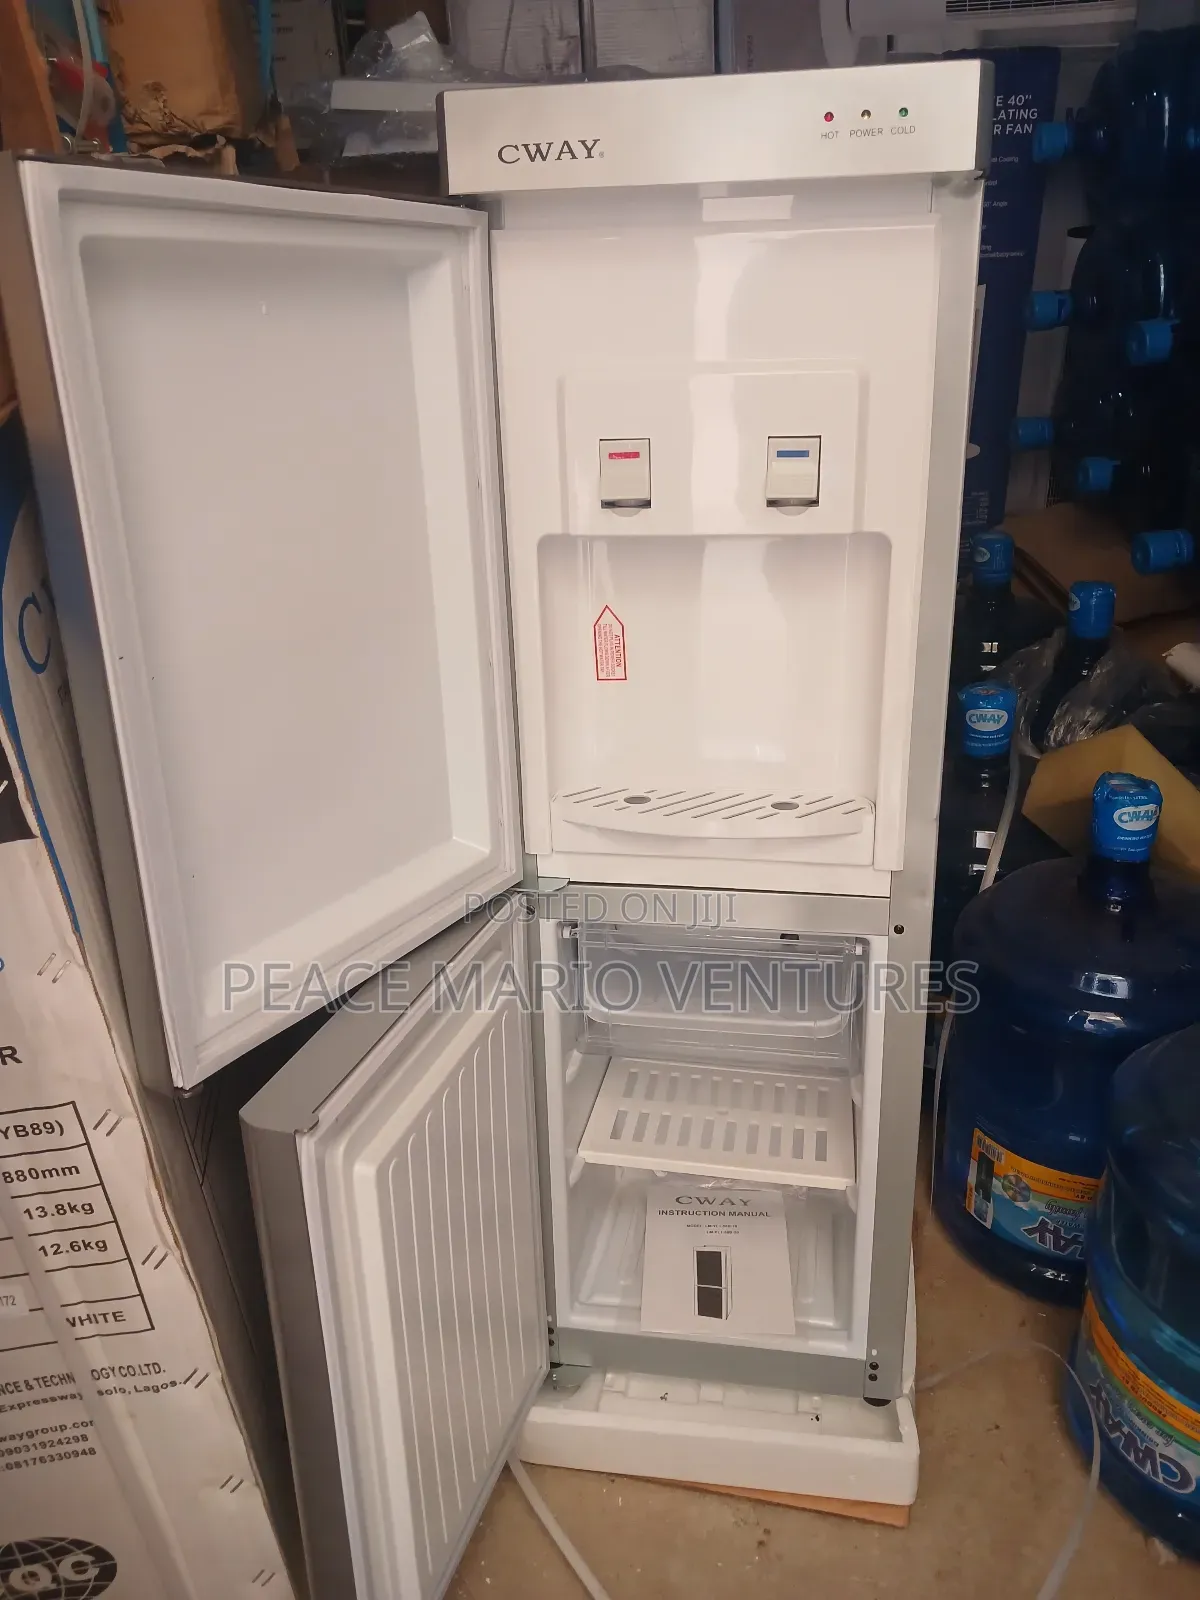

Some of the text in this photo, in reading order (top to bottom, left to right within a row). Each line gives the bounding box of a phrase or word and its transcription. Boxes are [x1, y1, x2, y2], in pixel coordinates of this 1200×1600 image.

[994, 95, 1004, 107] E
[992, 108, 1038, 120] ATING
[820, 125, 916, 140] HOT POWER COLD
[1005, 123, 1033, 135] FAN
[497, 138, 601, 165] CWAY
[614, 634, 622, 668] ATTENTION
[968, 713, 1004, 725] CWAY
[2, 1163, 81, 1185] 880mm
[675, 1195, 752, 1207] CWAY
[23, 1201, 95, 1221] 13.8kg
[658, 1209, 772, 1218] INSTRUCTION MANUAL
[1021, 1216, 1084, 1259] AY
[38, 1238, 109, 1258] 12.6kg
[24, 1378, 35, 1392] &
[1090, 1379, 1196, 1494] CWAY
